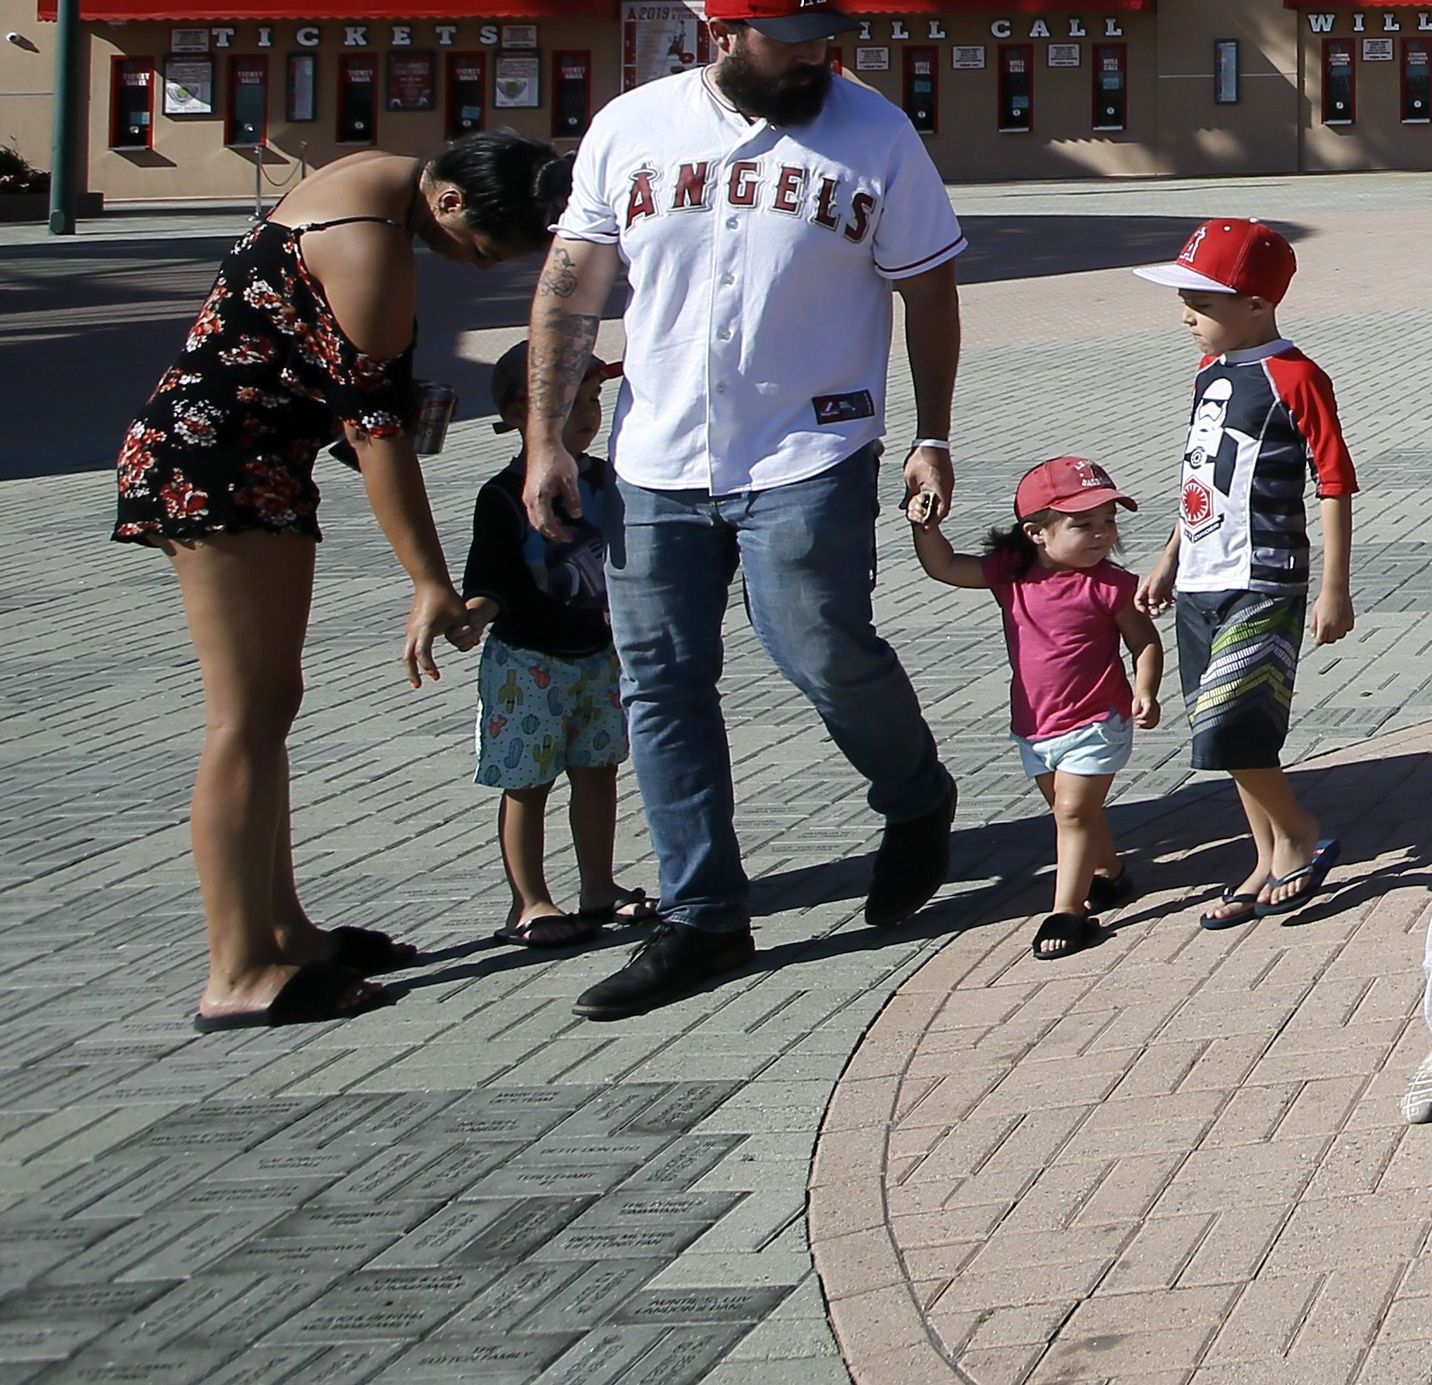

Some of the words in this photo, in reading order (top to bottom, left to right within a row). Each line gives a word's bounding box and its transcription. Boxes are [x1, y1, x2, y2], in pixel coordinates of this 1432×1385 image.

[640, 7, 670, 20] 2019
[212, 25, 498, 47] TICKETS
[858, 20, 946, 39] ILL
[991, 18, 1122, 38] CALL
[623, 161, 878, 244] ANGELS
